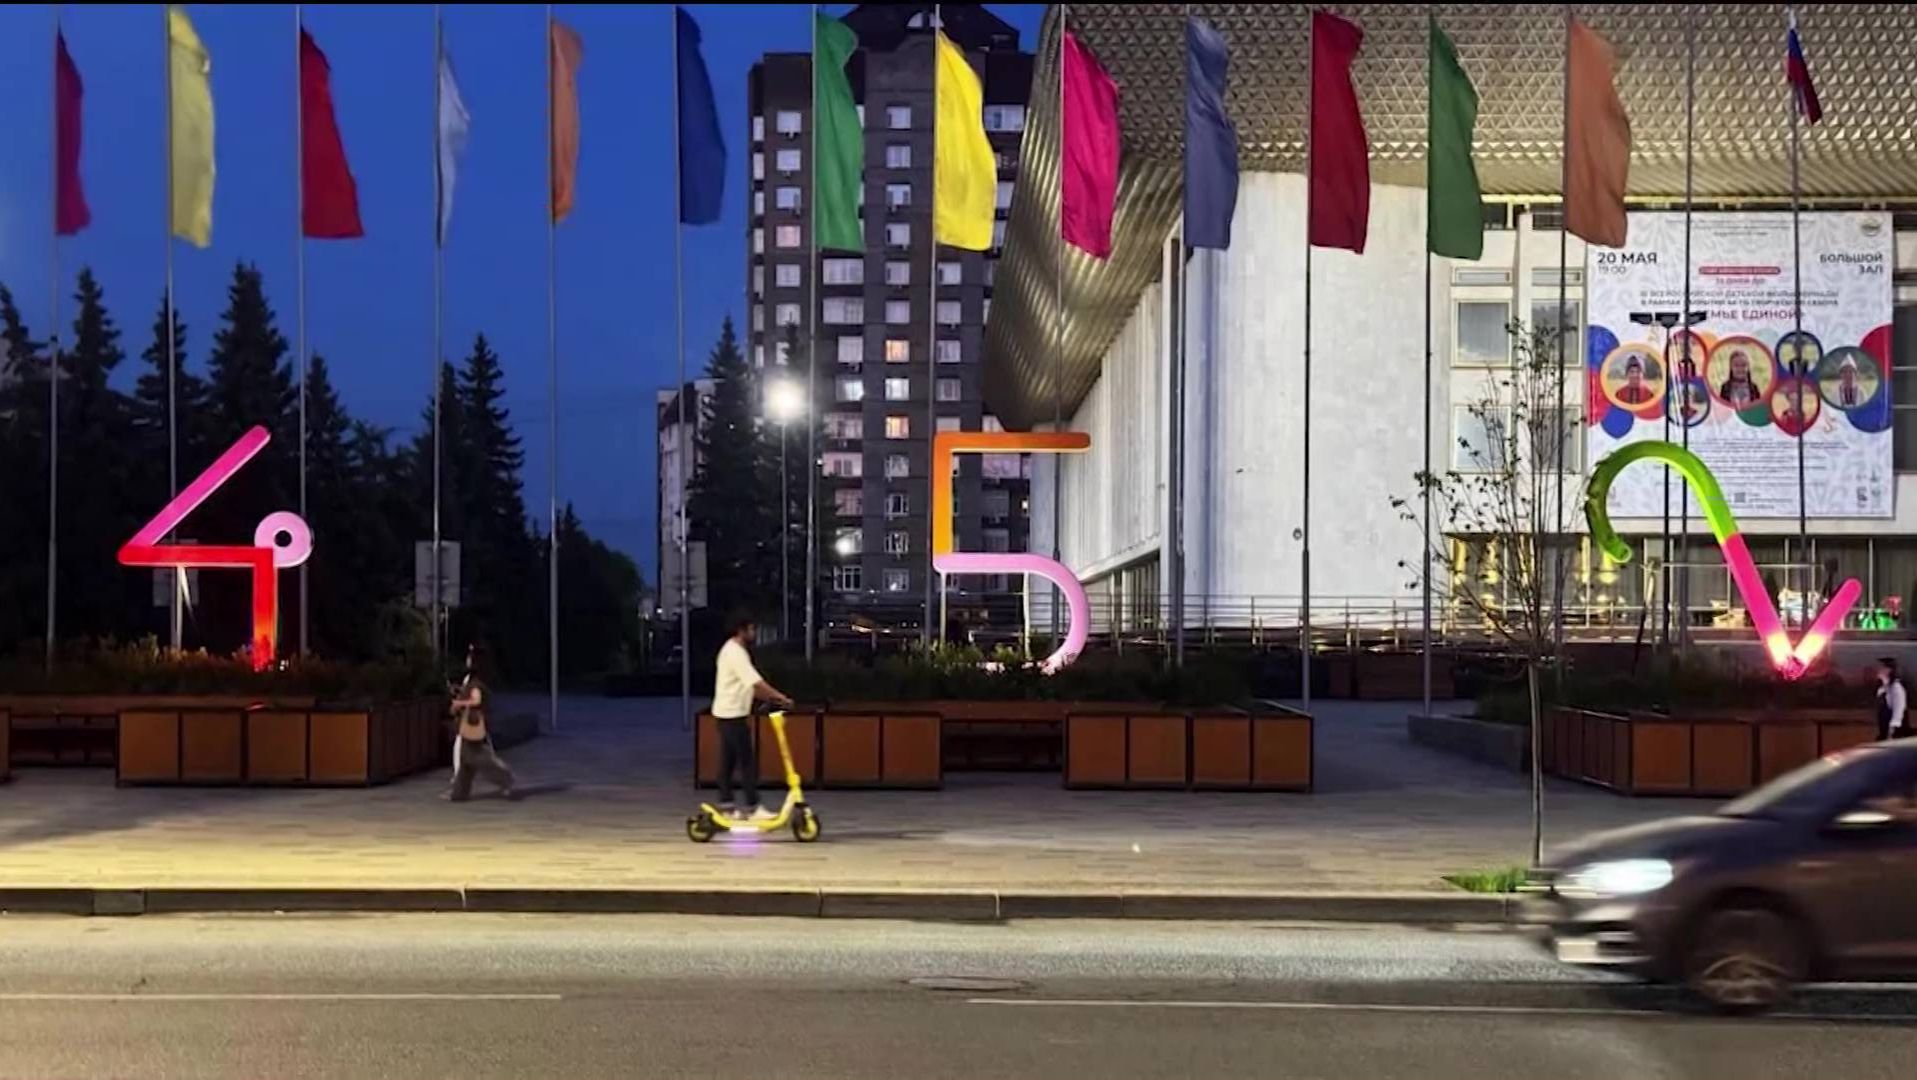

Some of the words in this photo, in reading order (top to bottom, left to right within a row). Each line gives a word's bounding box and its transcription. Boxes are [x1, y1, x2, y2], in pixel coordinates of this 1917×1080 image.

[1598, 252, 1616, 264] 20
[1621, 252, 1657, 264] МАЯ
[1820, 251, 1883, 263] БОЛЬШОЙ
[1859, 264, 1883, 274] ЗАЛ
